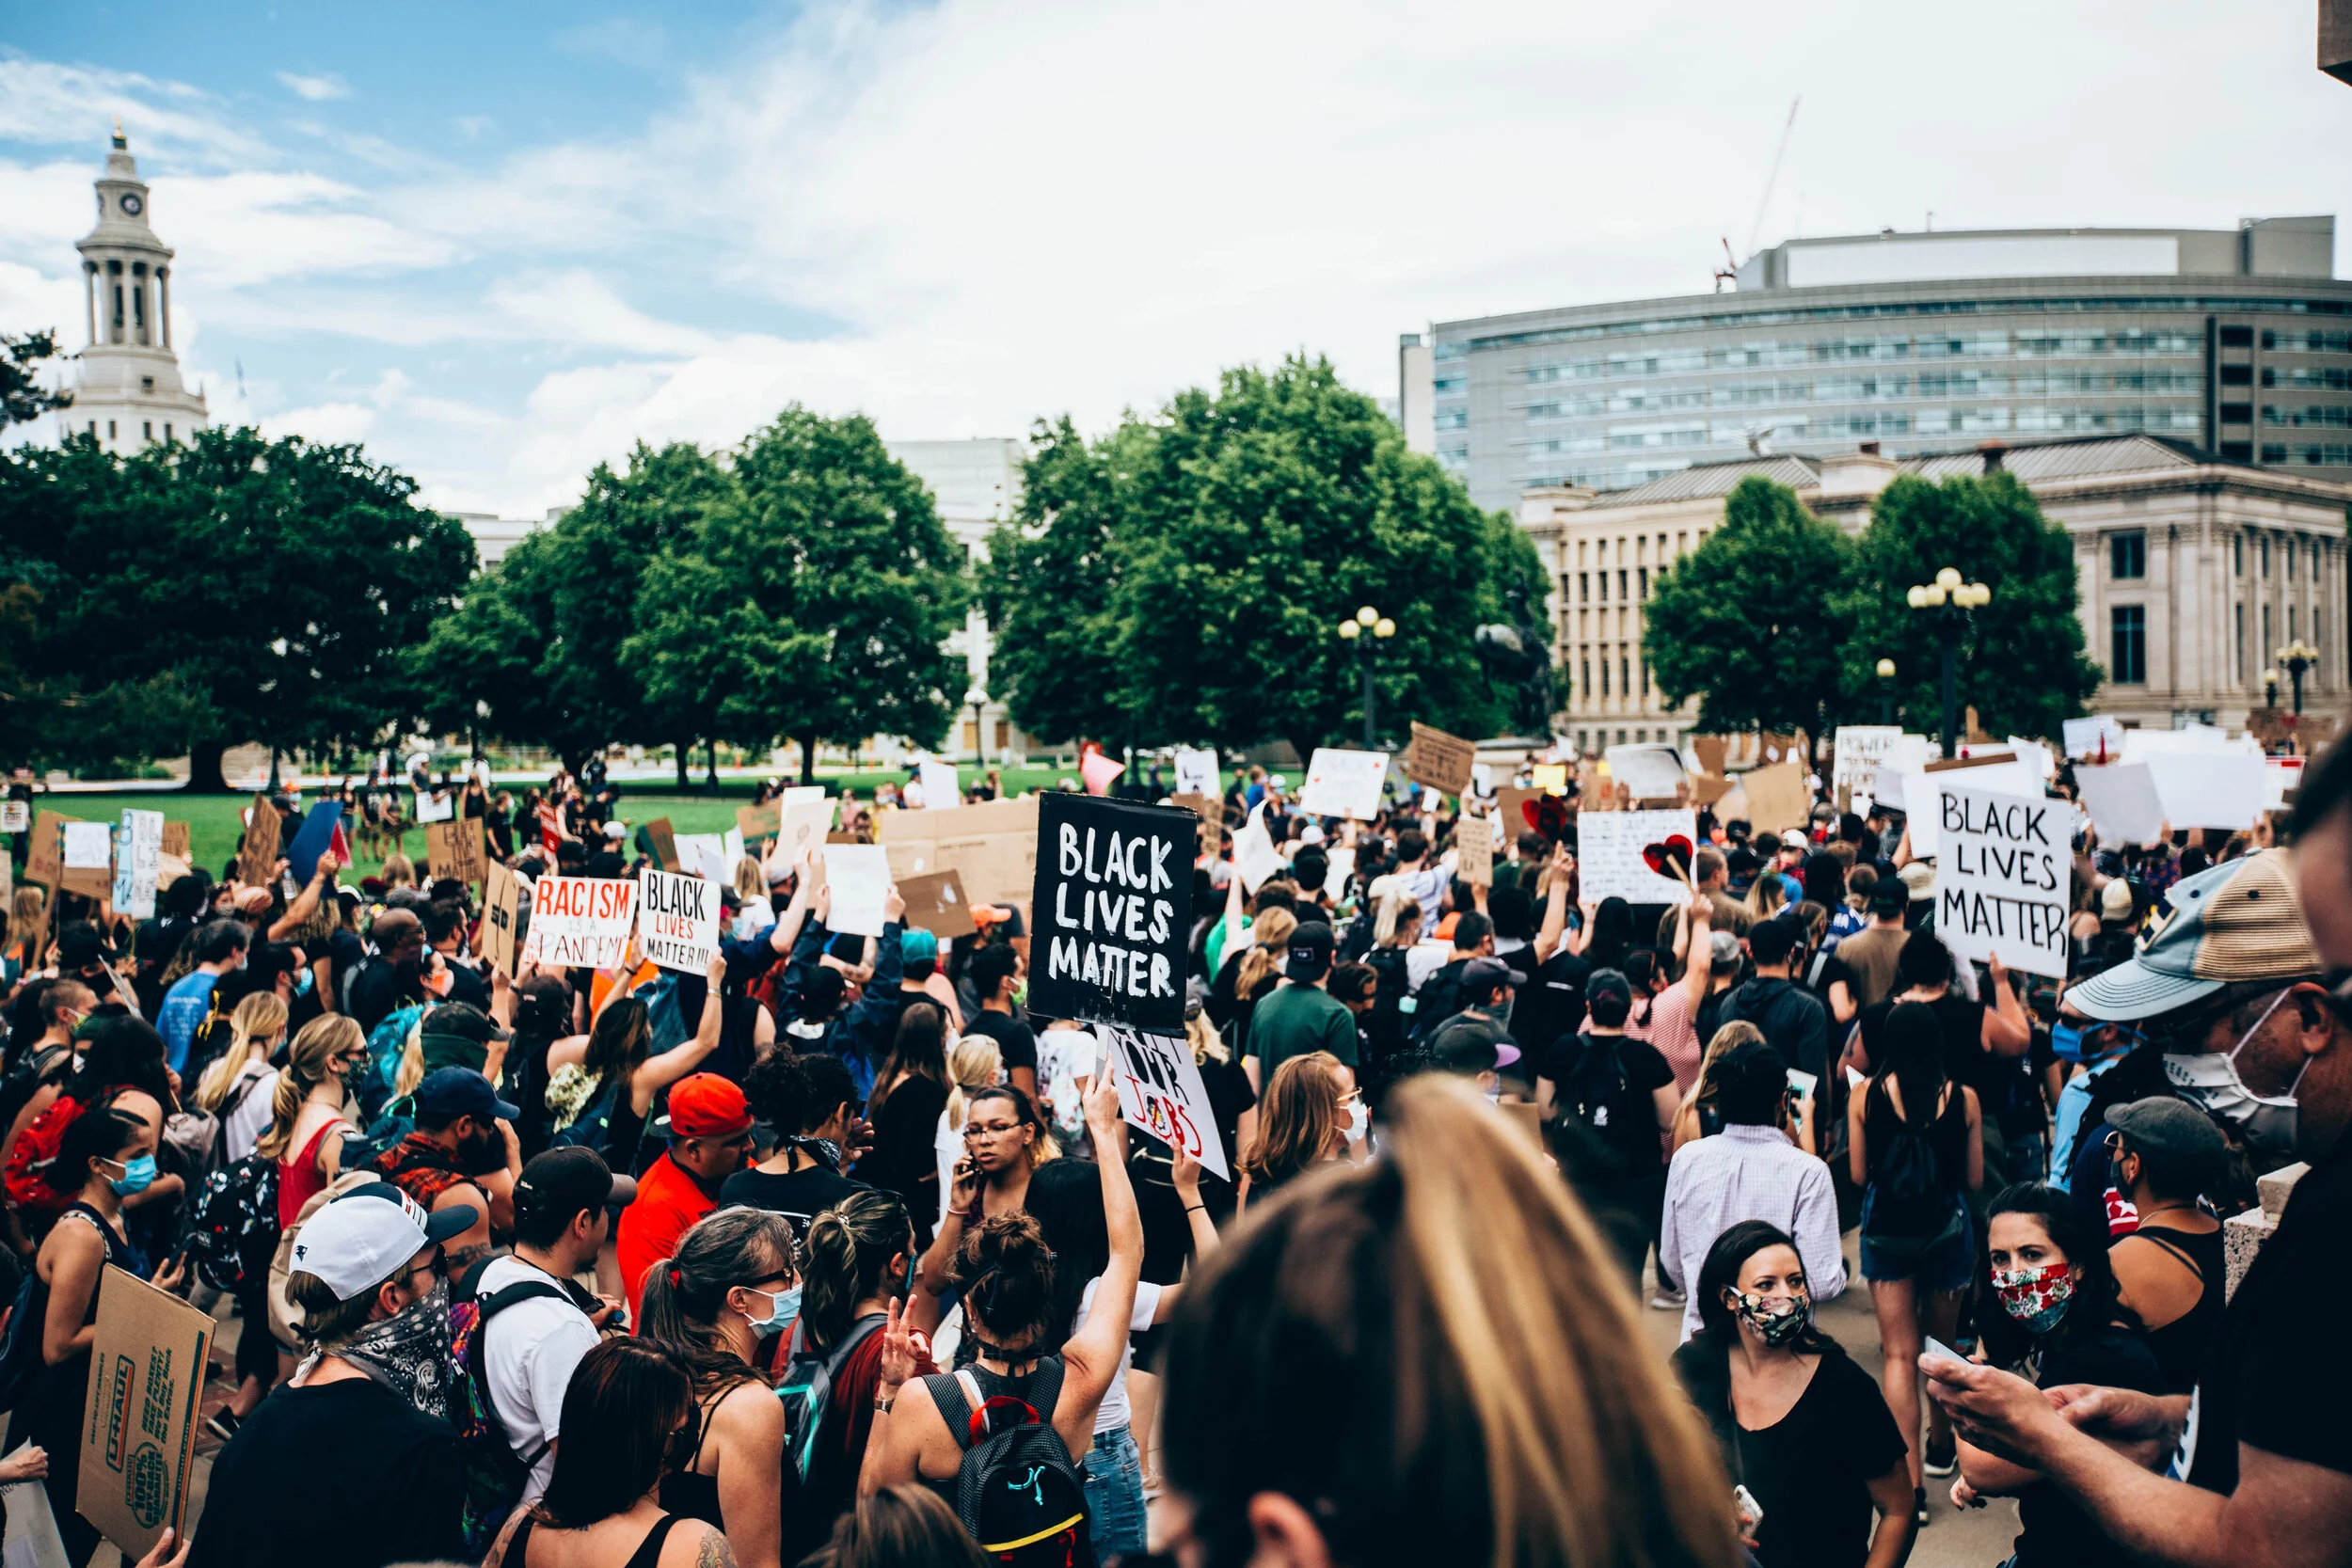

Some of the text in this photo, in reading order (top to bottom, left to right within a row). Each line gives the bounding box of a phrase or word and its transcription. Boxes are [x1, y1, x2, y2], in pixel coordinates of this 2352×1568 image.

[1840, 735, 1894, 752] POWER
[1941, 792, 2049, 846] BLACK
[1059, 822, 1173, 894] BLACK
[1958, 843, 2058, 891] LIVES
[535, 880, 630, 919] RACISM
[648, 873, 705, 921] BLACK
[1056, 882, 1174, 944] LIVES
[1944, 887, 2066, 957] MATTER
[568, 918, 596, 933] IS A
[647, 938, 708, 968] MATTER!!!
[656, 914, 693, 939] LIVES
[1048, 936, 1176, 998] MATTER
[1110, 1031, 1190, 1106] YOUR
[141, 1346, 158, 1432] NEED BOXES?
[163, 1348, 172, 1380] Back
[109, 1366, 129, 1462] U-HAUL
[148, 1351, 164, 1435] TAKE PLENTY!
[164, 1378, 174, 1421] Extras.
[135, 1454, 148, 1510] 100%
[146, 1450, 156, 1522] BUY-BACK
